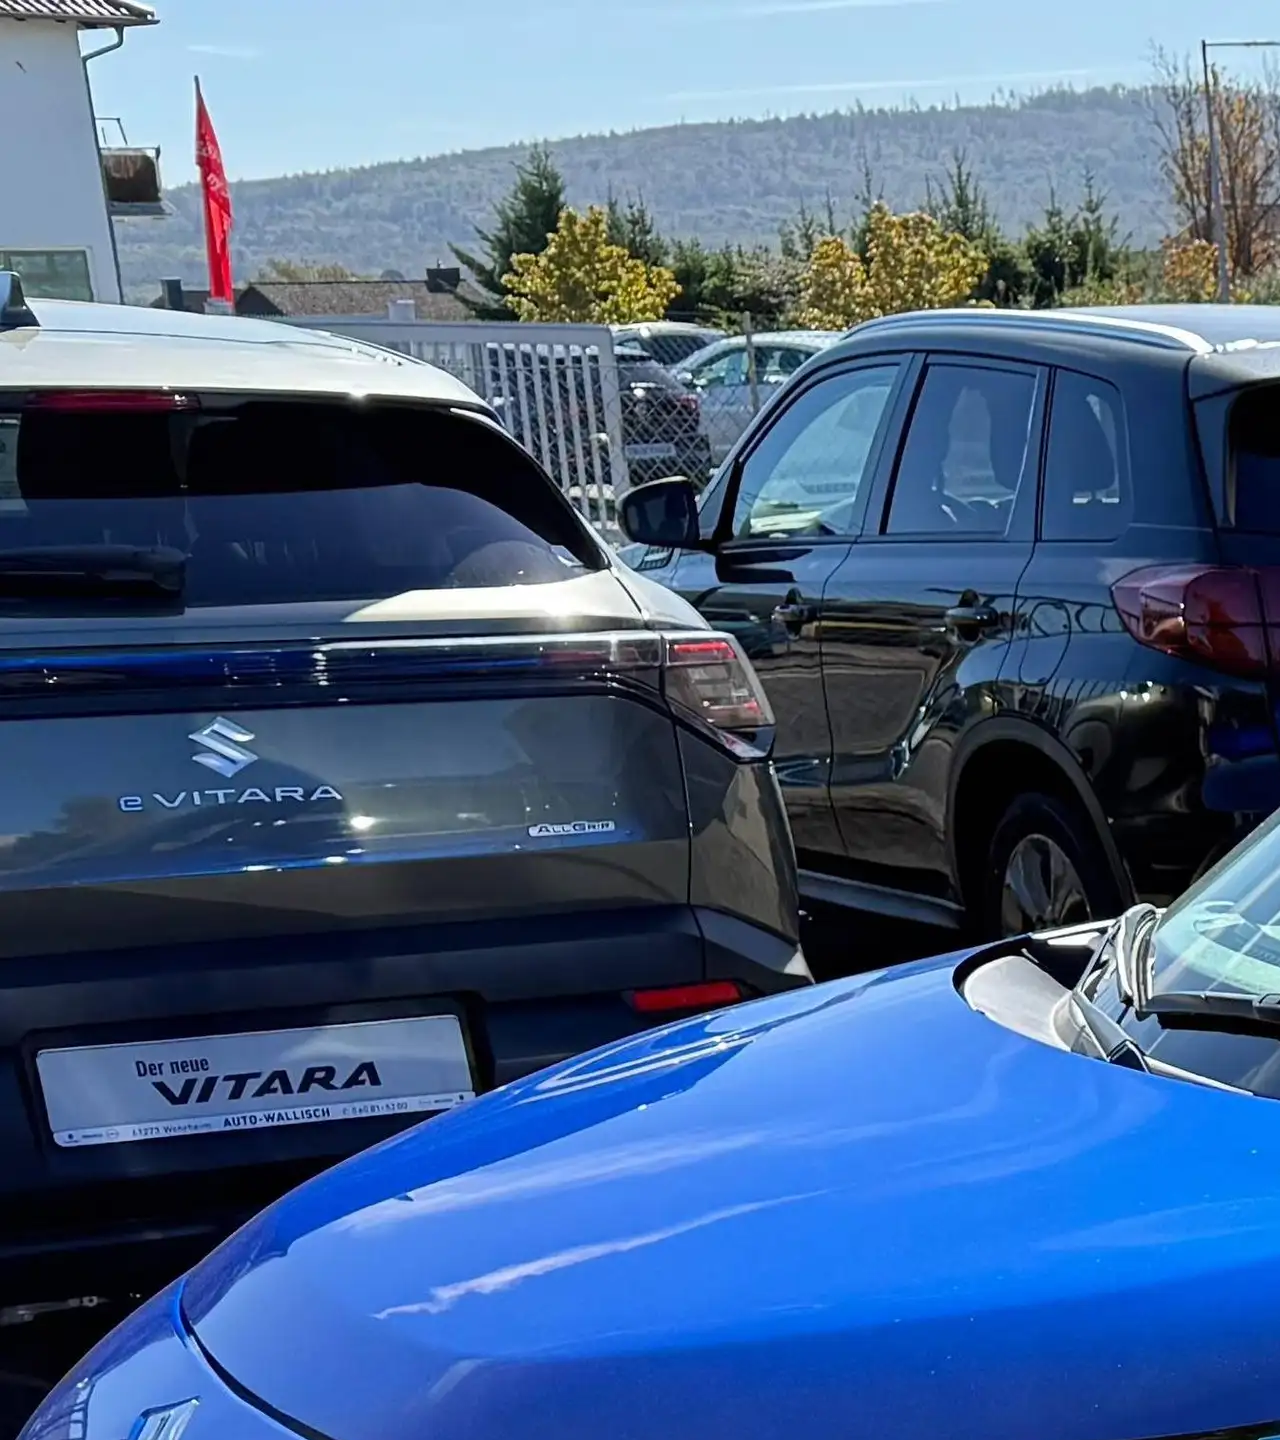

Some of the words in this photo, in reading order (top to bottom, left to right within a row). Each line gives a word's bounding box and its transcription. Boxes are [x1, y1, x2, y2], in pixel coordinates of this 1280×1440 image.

[119, 794, 144, 812] e
[152, 785, 344, 808] VITARA
[135, 1060, 164, 1078] Der
[170, 1057, 210, 1075] neue
[151, 1061, 383, 1106] VITARA
[223, 1107, 331, 1128] AUTO-WALLISCH
